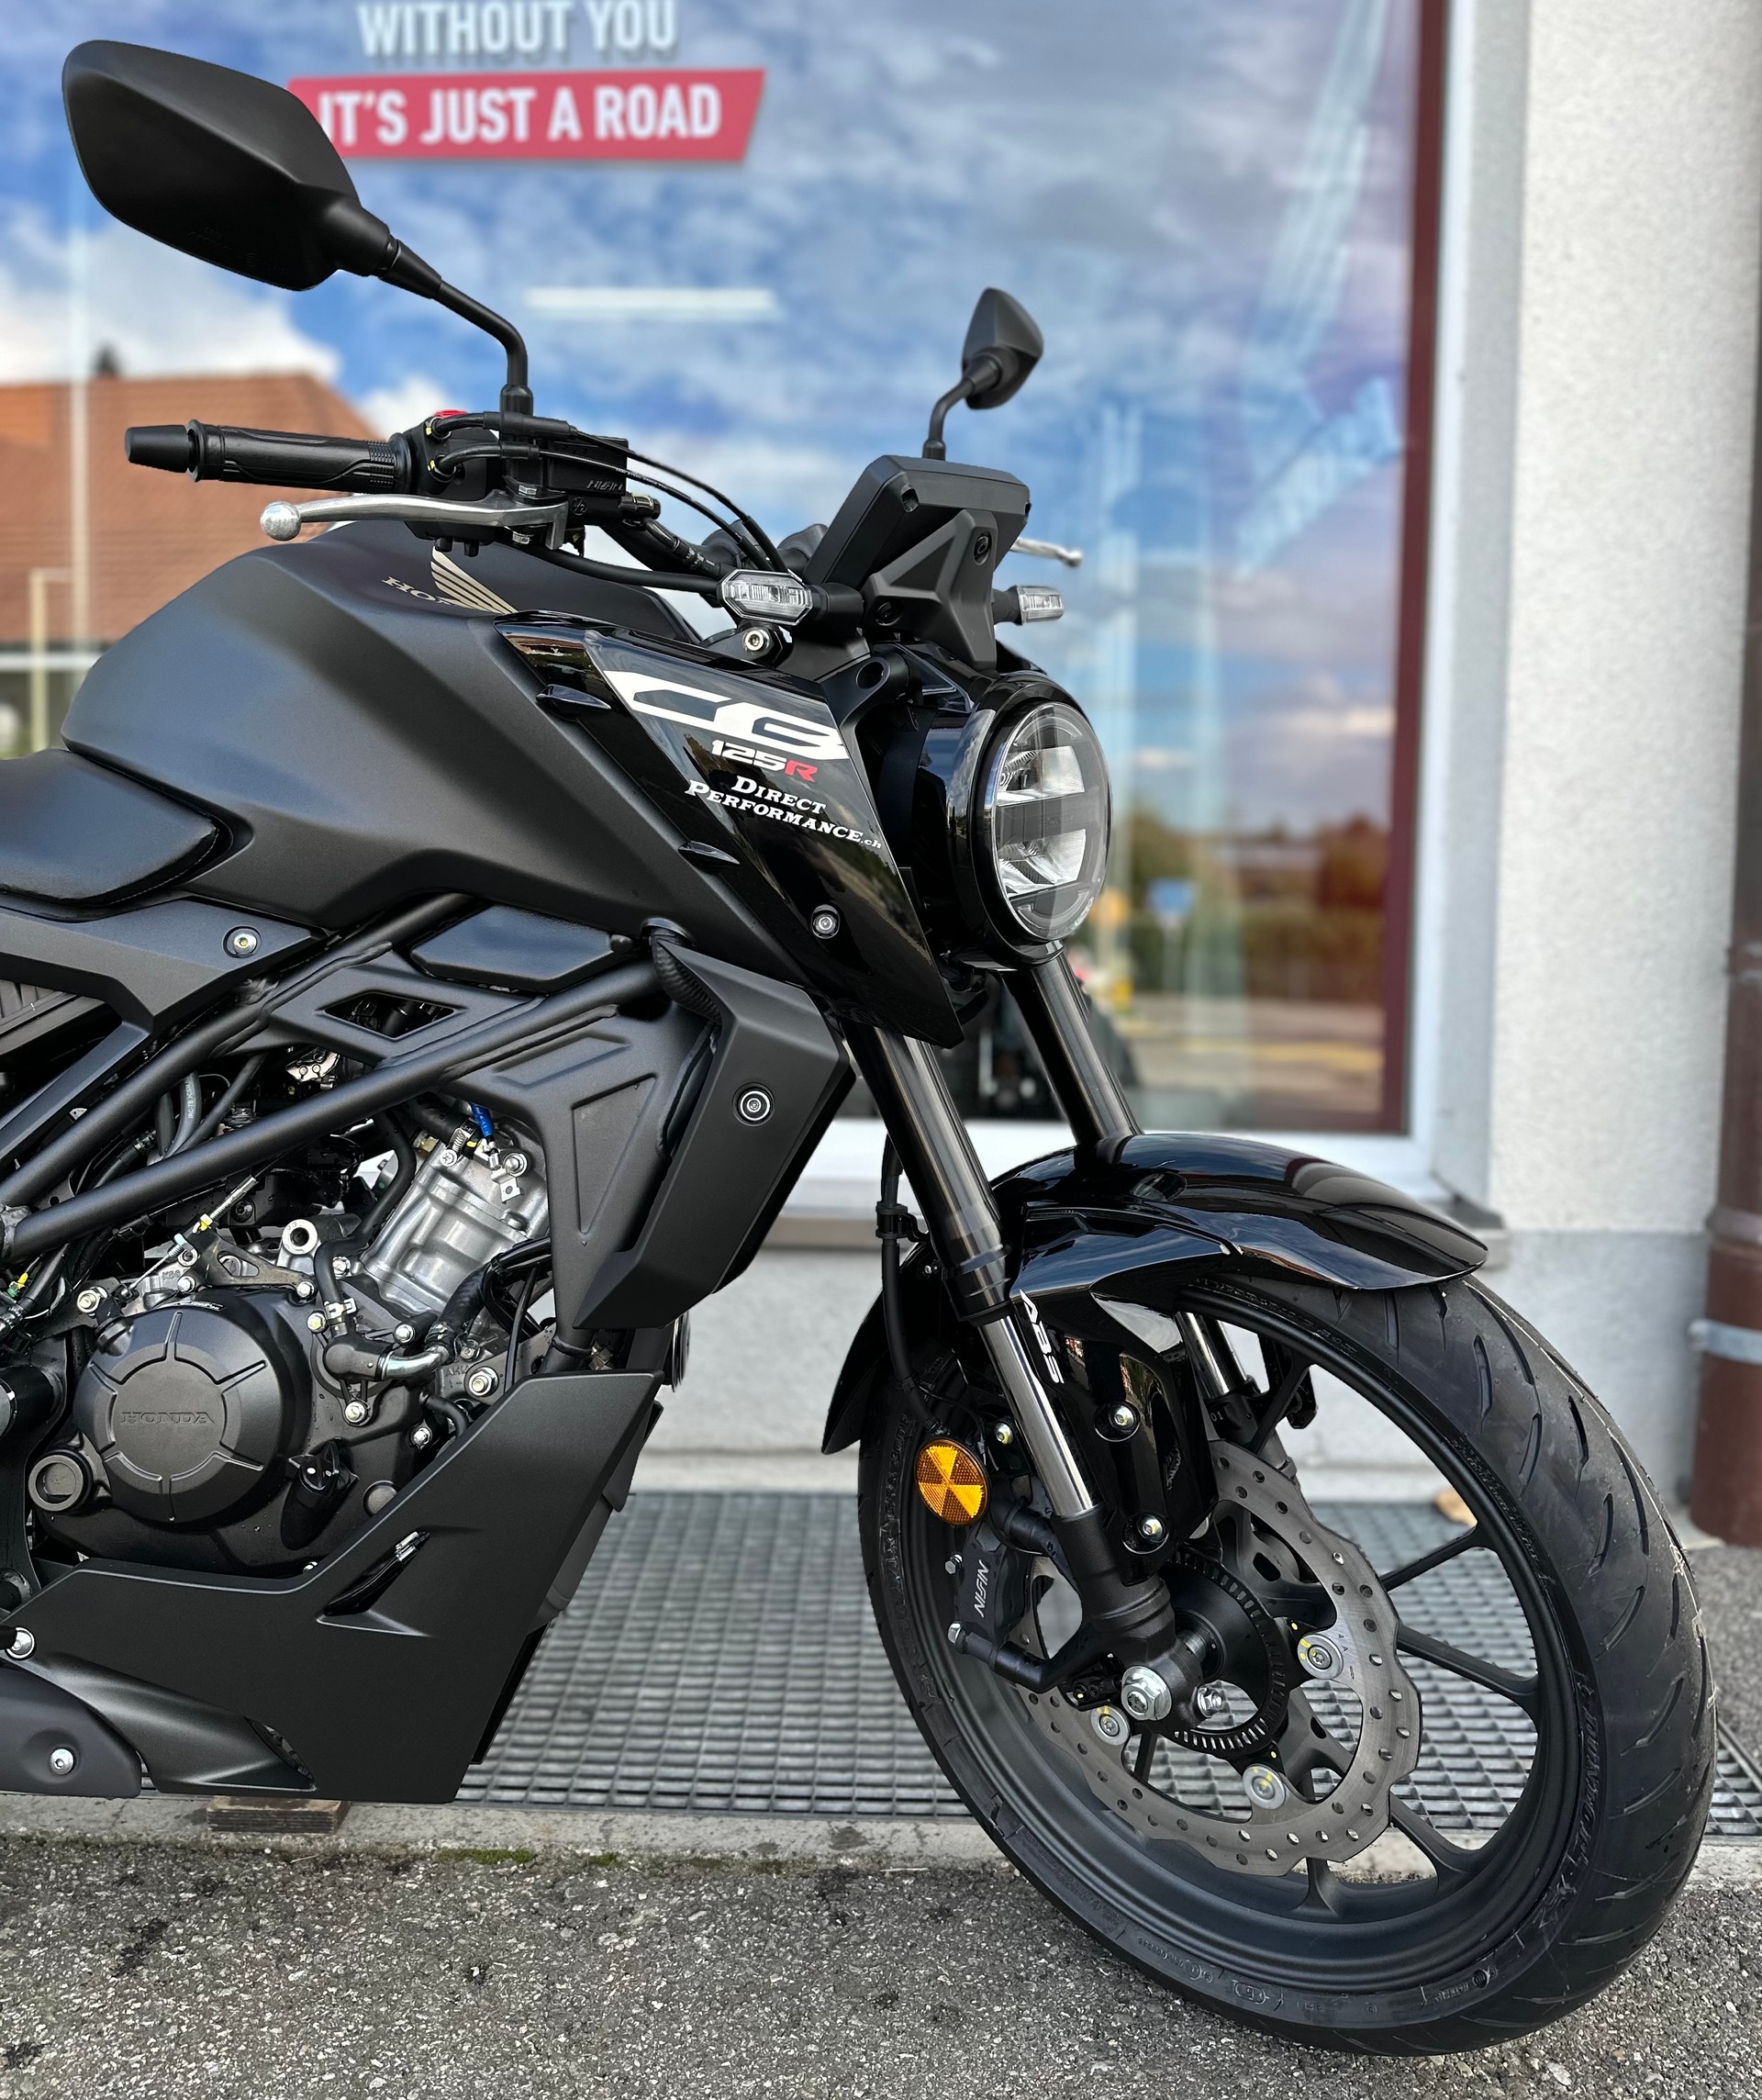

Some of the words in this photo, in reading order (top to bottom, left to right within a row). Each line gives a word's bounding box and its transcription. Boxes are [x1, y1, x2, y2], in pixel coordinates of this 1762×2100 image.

[357, 0, 569, 56] WITHOUT
[585, 0, 678, 50] YOU
[318, 90, 407, 146] IT'S
[419, 88, 537, 144] JUST
[547, 87, 581, 140] A
[596, 84, 721, 140] ROAD
[710, 740, 819, 783] 125R
[1019, 1288, 1065, 1384] ABS
[120, 1412, 216, 1424] HONDA
